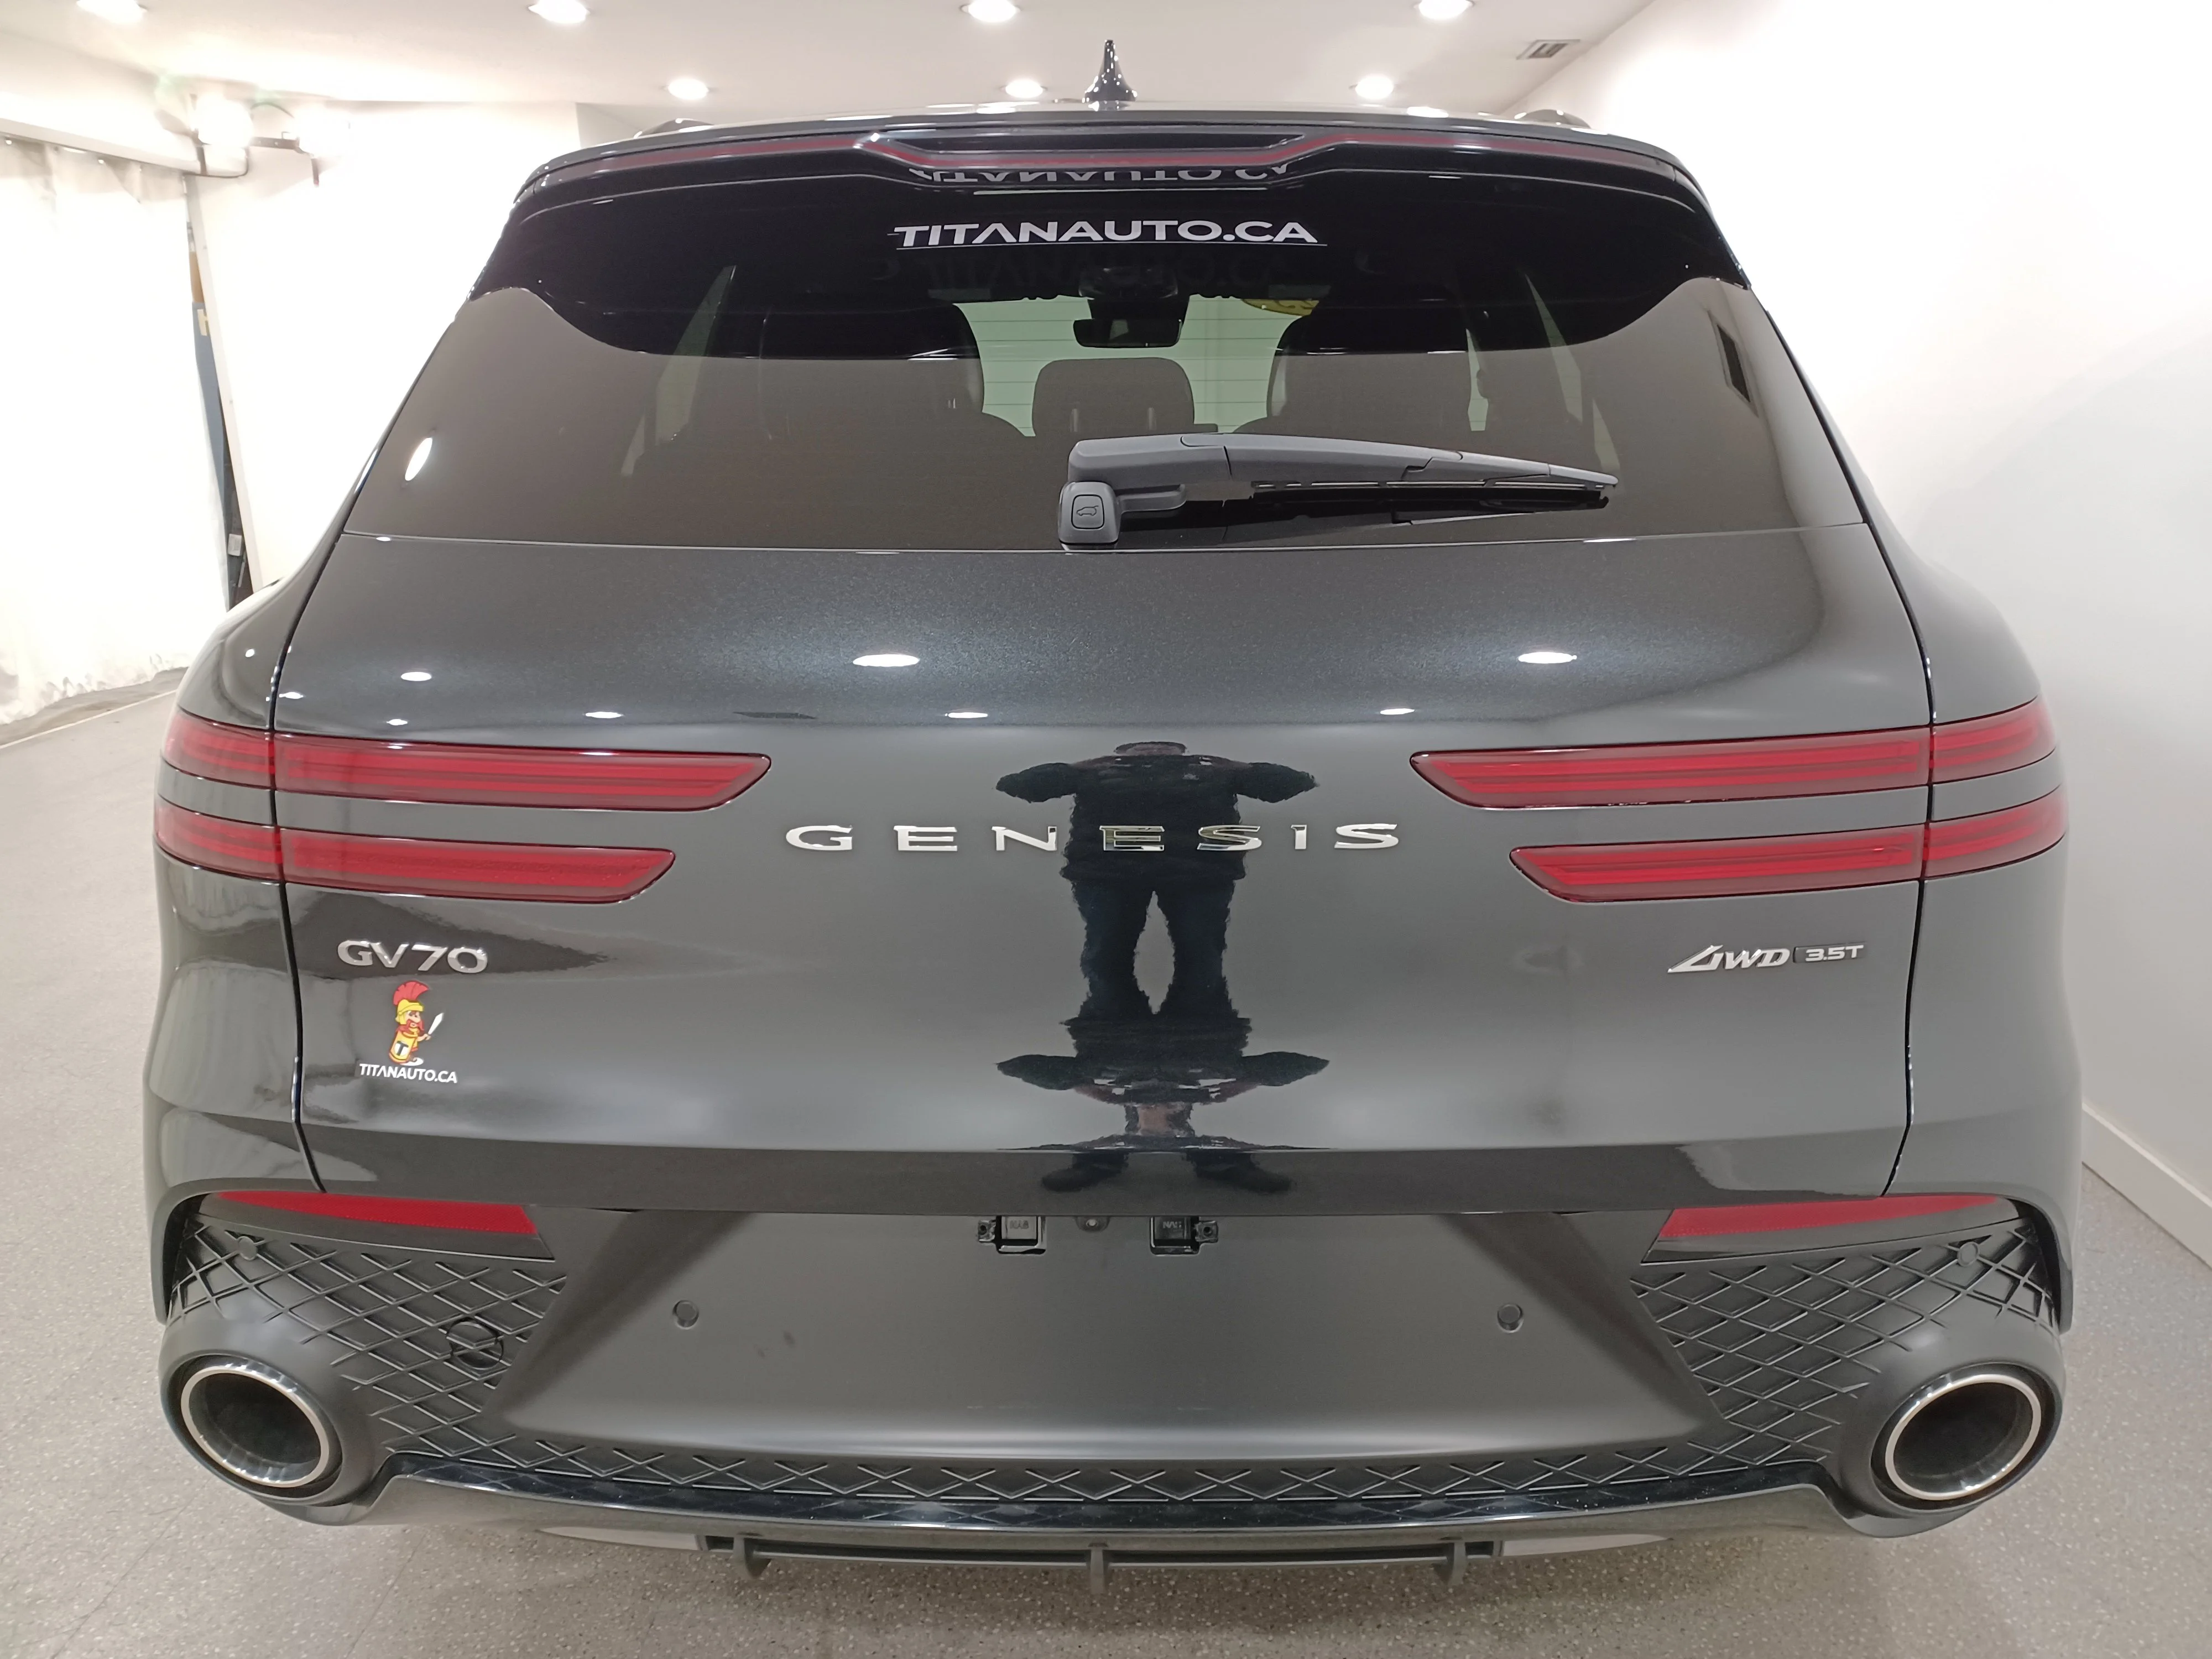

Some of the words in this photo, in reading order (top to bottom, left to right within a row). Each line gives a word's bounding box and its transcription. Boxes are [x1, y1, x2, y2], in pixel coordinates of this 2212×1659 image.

[894, 220, 1318, 247] TITANAUTO.CA
[785, 823, 1399, 852] GENESIS
[337, 939, 488, 973] GV70
[1667, 945, 1791, 973] AWD
[1805, 945, 1864, 962] 3.5T
[396, 1041, 409, 1056] T
[359, 1063, 458, 1084] TITANAUTO.CA
